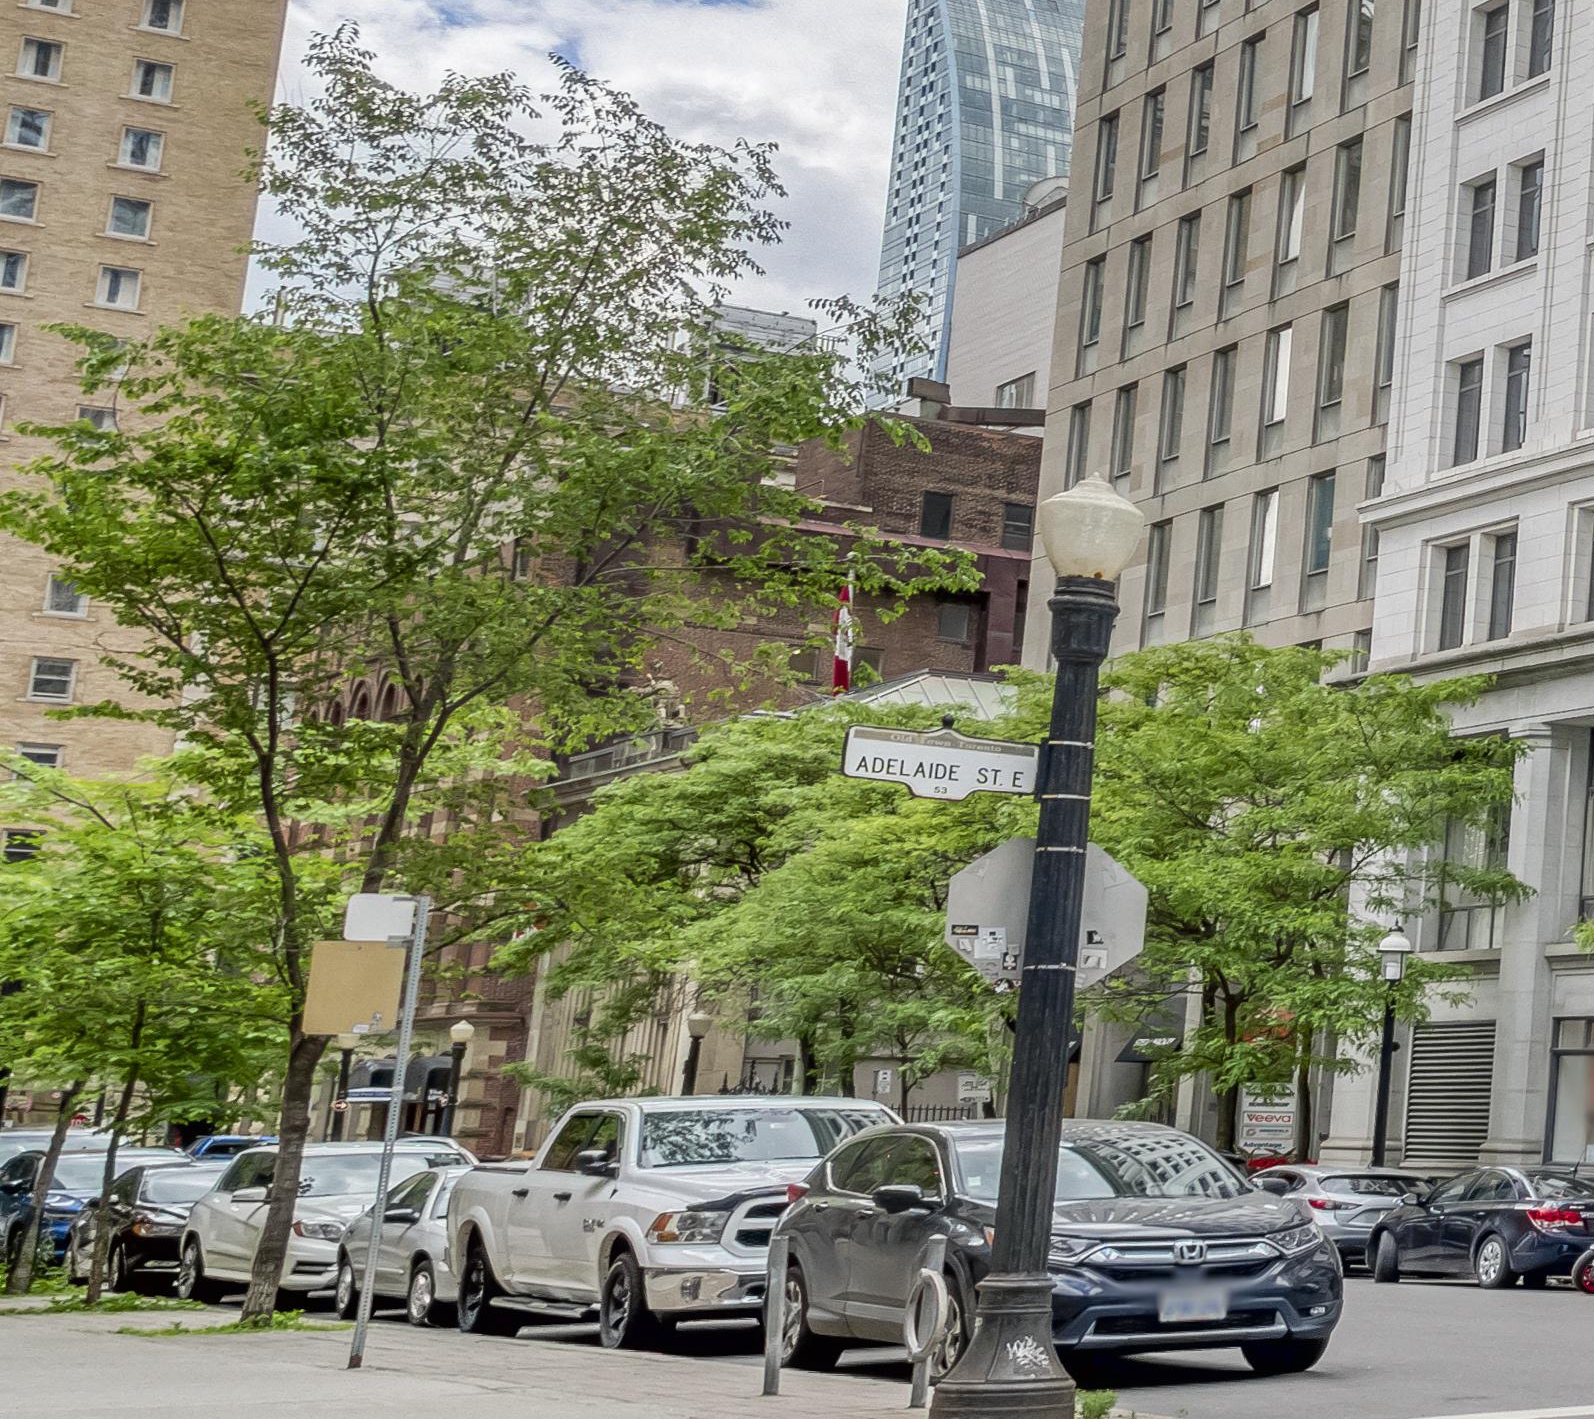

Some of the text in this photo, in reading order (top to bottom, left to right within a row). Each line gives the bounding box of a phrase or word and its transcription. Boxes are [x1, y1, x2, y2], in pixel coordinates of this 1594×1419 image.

[856, 756, 1024, 788] ADELAIDE ST. E
[934, 786, 948, 795] 53
